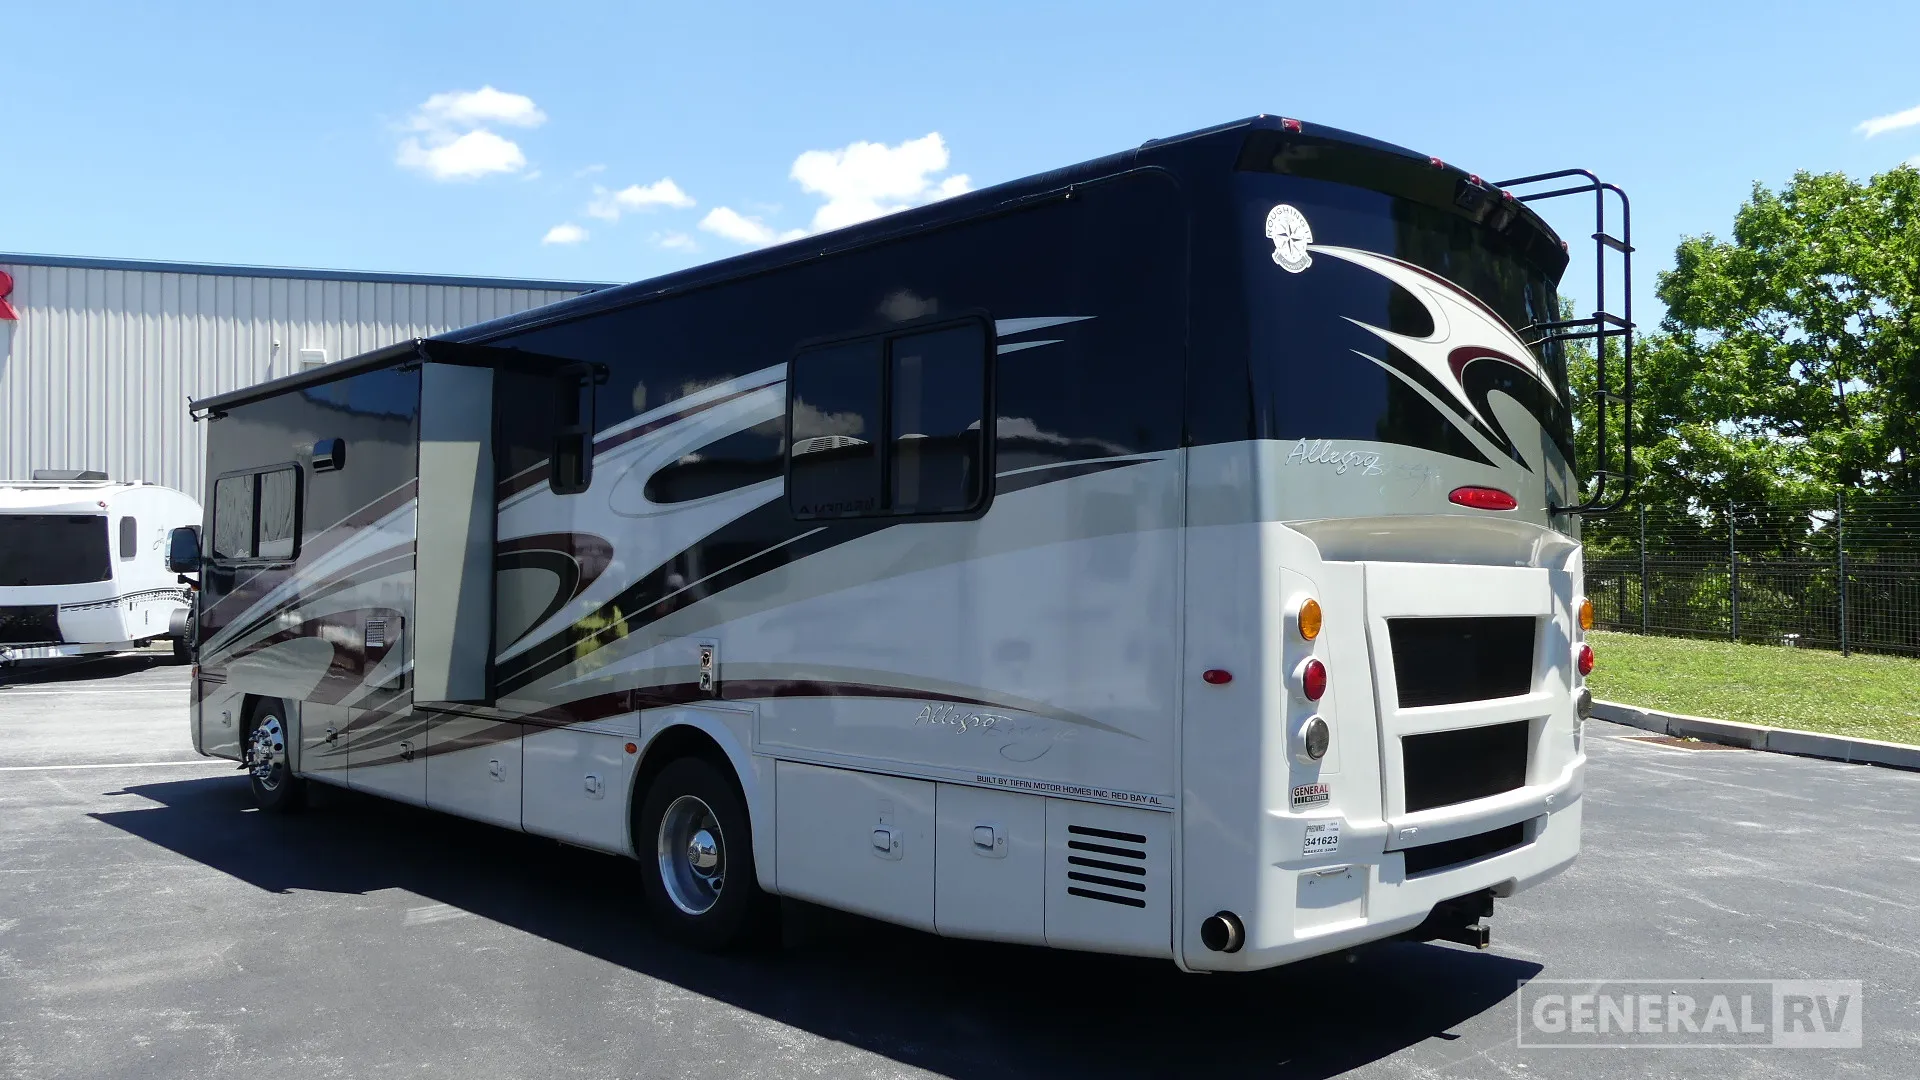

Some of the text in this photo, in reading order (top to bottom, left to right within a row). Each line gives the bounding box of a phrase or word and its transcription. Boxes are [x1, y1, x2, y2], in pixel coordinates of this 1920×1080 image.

[1285, 438, 1383, 475] Allegro
[914, 703, 1012, 735] Allegro
[976, 775, 997, 784] BUILT
[998, 777, 1008, 786] BY
[1009, 779, 1032, 789] TIFFIN
[1033, 782, 1061, 793] MOTOR
[1062, 785, 1092, 796] HOMES
[1111, 791, 1129, 801] RED
[1130, 794, 1148, 803] BAY
[1294, 785, 1328, 796] GENERAL
[1304, 835, 1338, 847] 341623
